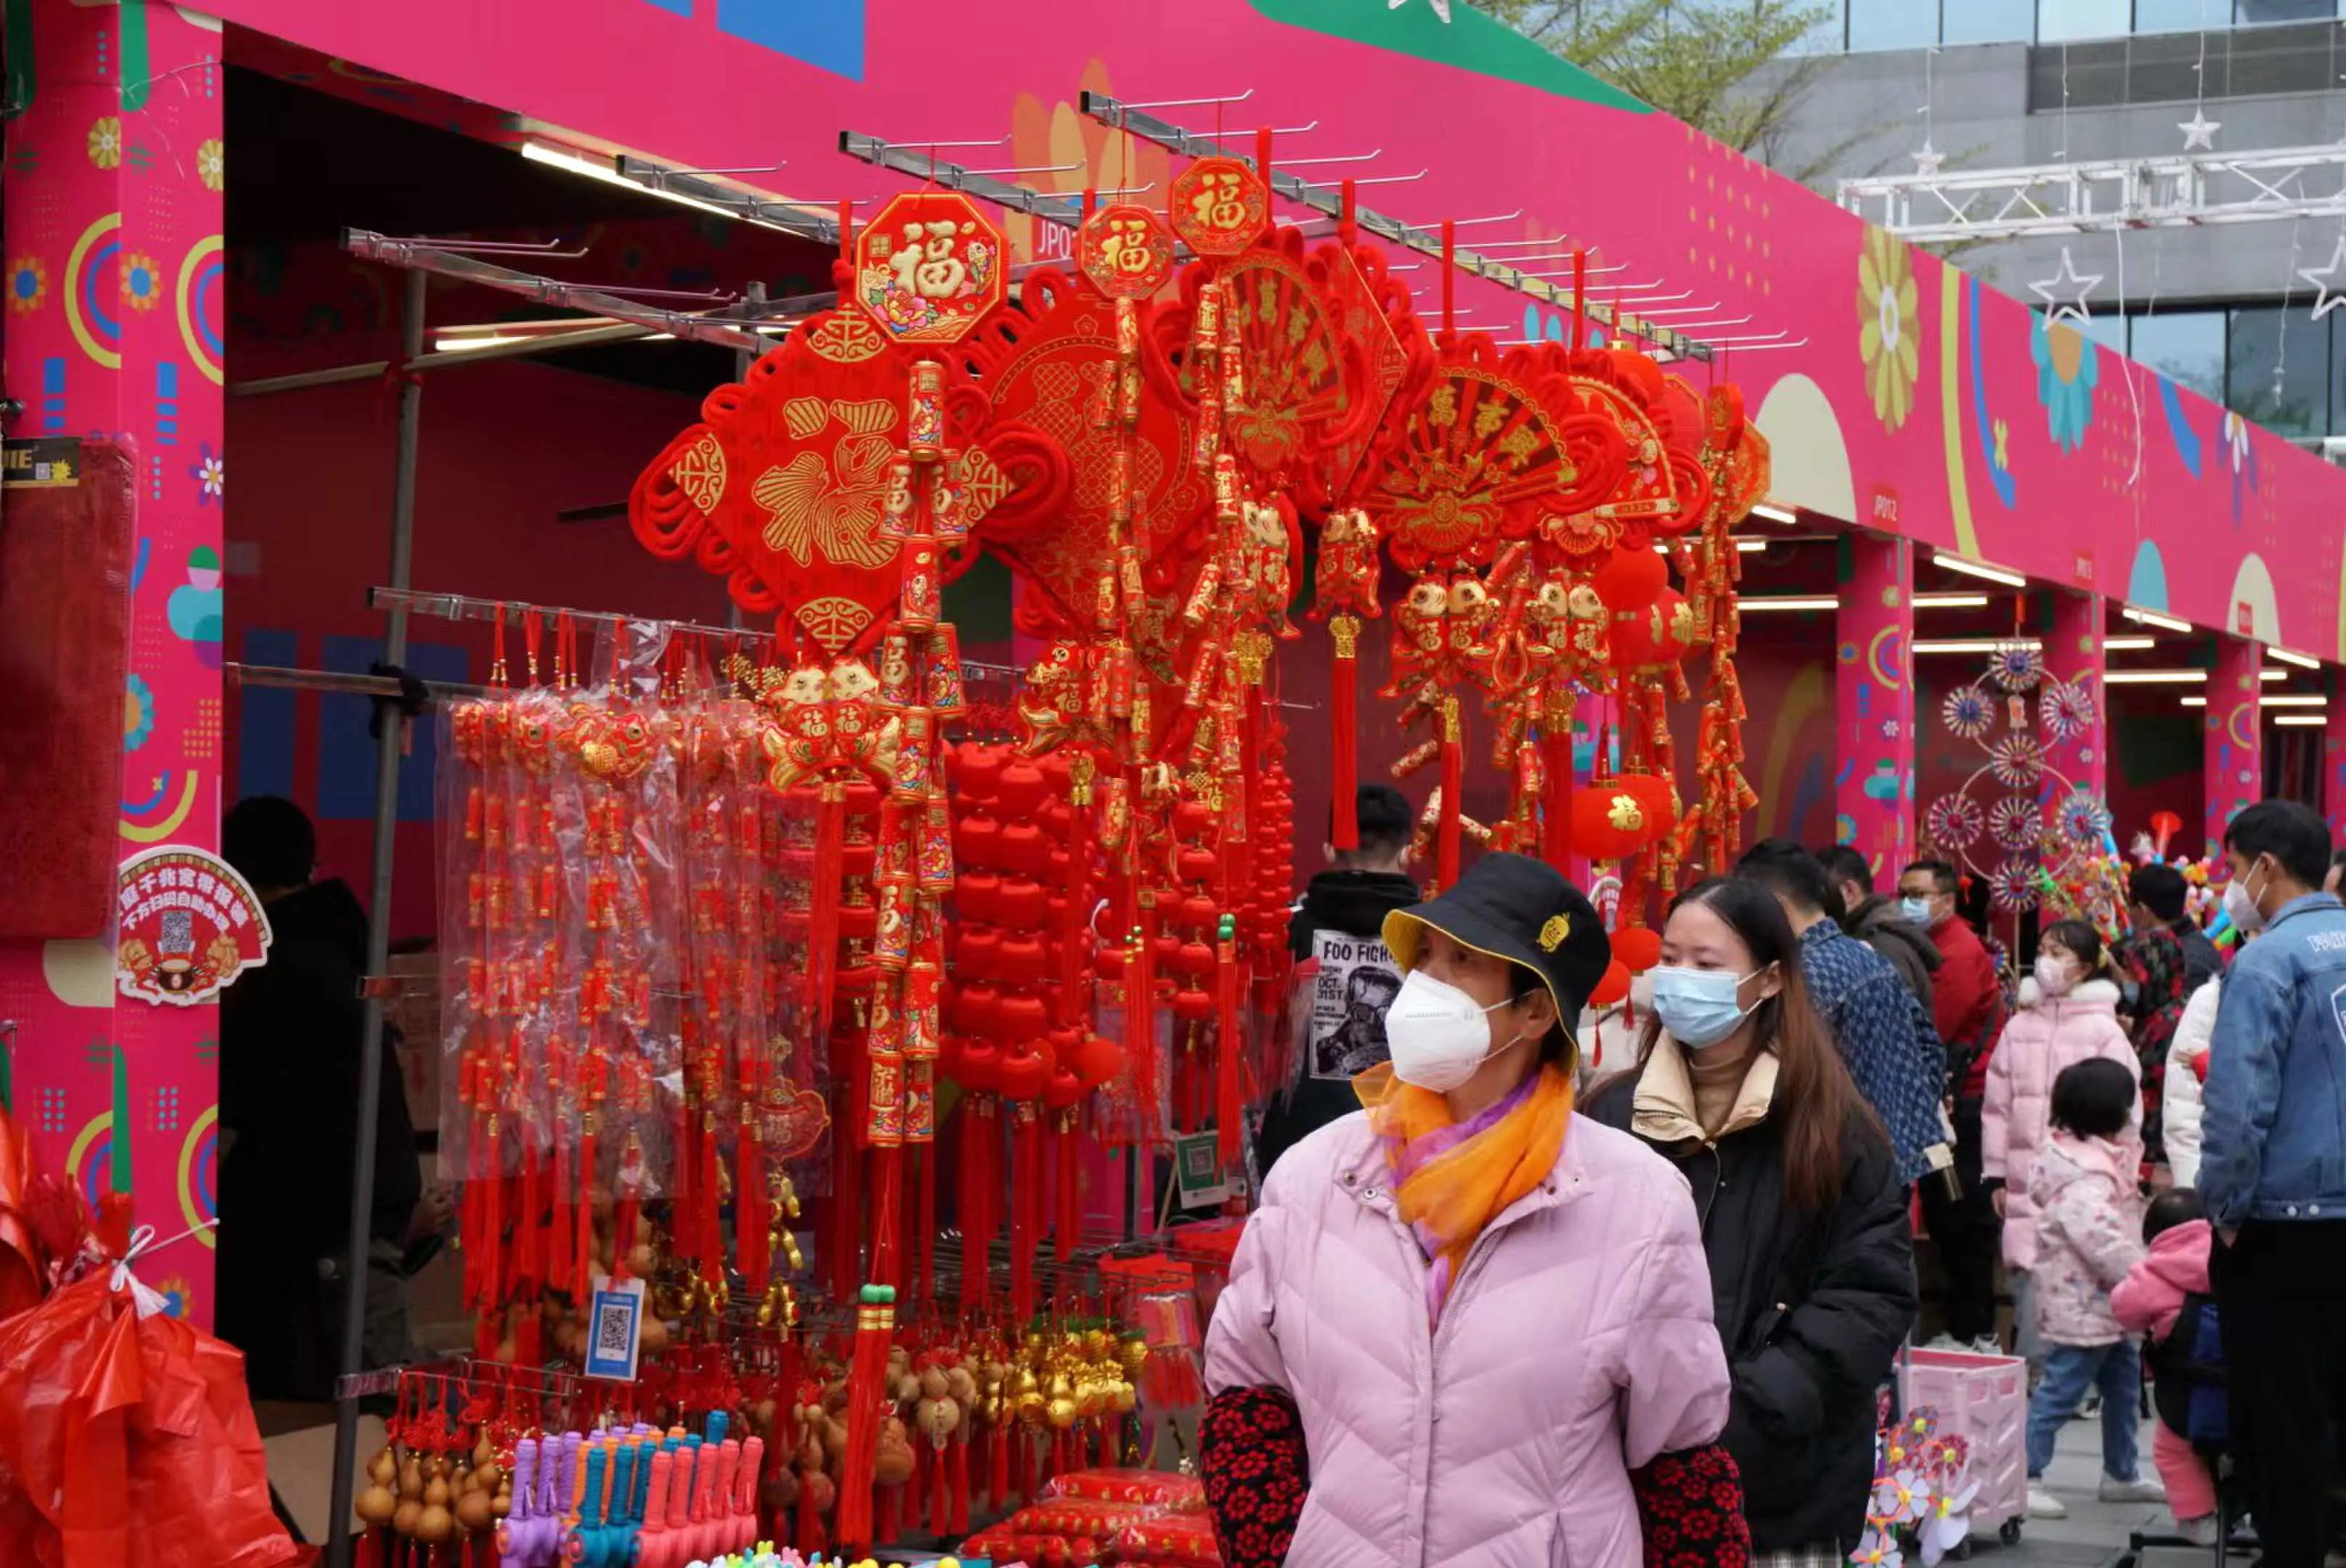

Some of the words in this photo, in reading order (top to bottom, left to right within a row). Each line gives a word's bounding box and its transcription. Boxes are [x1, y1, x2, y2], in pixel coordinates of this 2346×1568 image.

[1192, 173, 1246, 229] 福
[888, 219, 966, 299] 福
[1100, 219, 1151, 272] 福
[752, 396, 902, 569] 福
[799, 711, 828, 738] 福
[835, 706, 862, 734] 福
[1323, 940, 1352, 961] FOO
[1357, 944, 1397, 964] FIGH
[1317, 989, 1344, 1000] 31ST
[1318, 978, 1341, 989] OCT.
